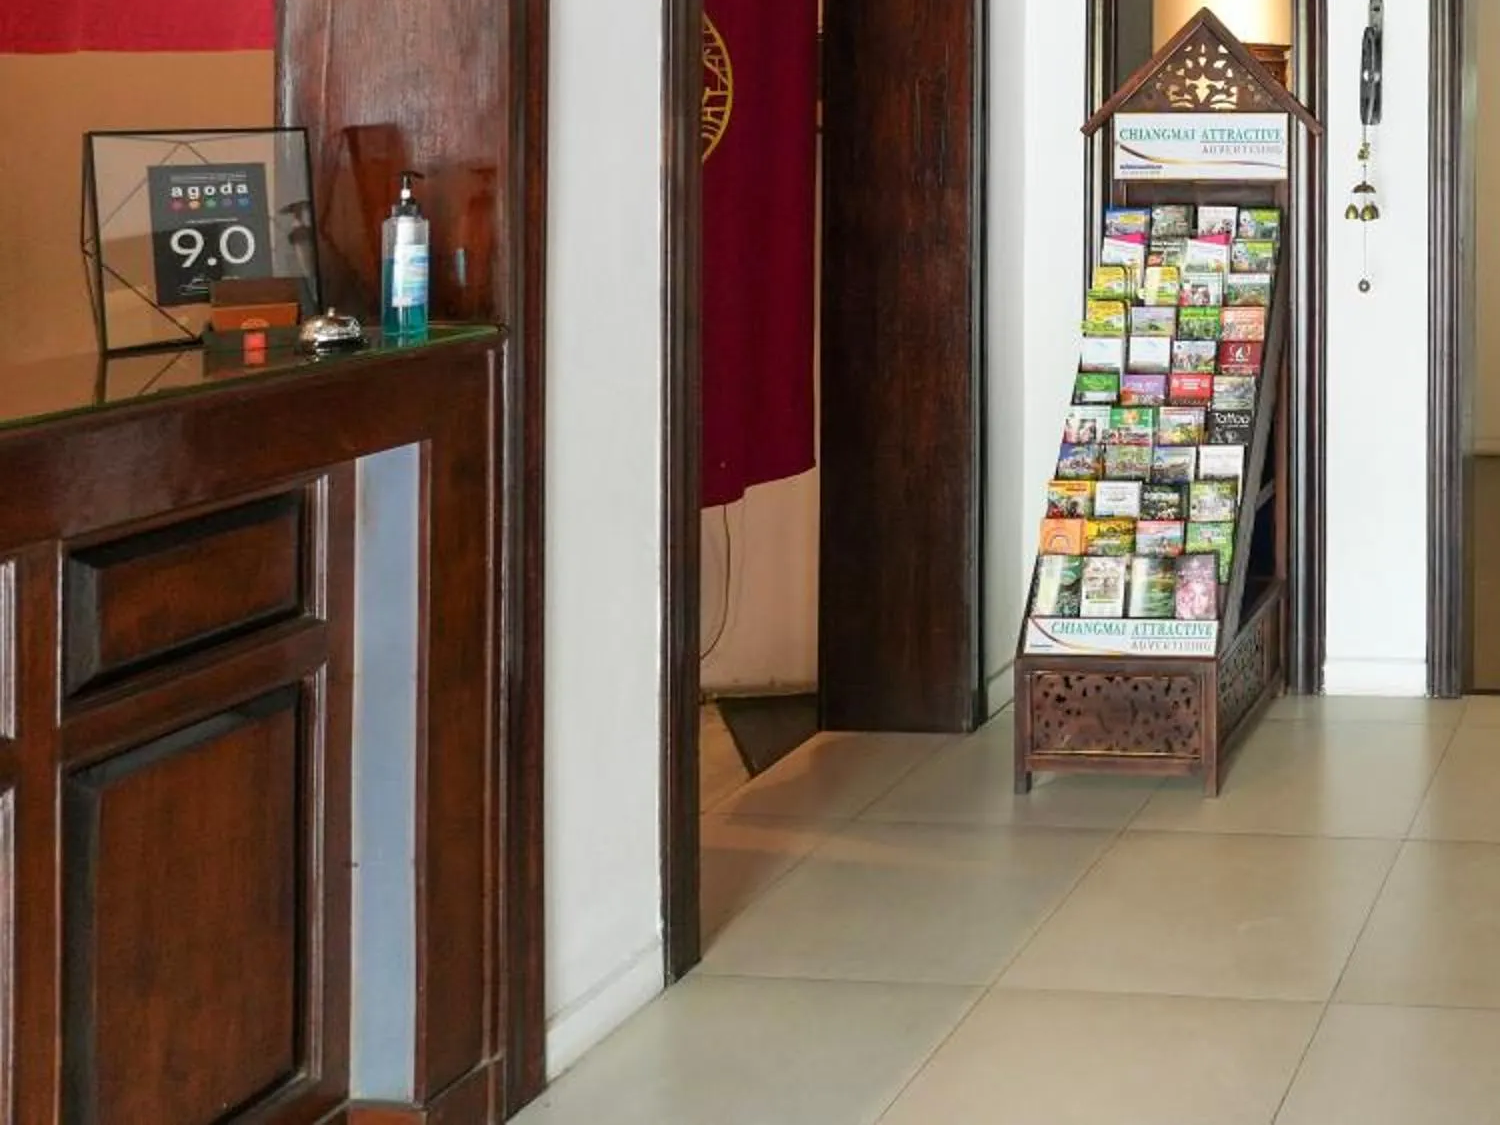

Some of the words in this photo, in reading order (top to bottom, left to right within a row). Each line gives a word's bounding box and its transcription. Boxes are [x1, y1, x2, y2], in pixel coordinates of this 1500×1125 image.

[1200, 128, 1281, 141] ATTRACTIVE
[170, 182, 249, 200] agoda
[170, 225, 255, 268] 9.0
